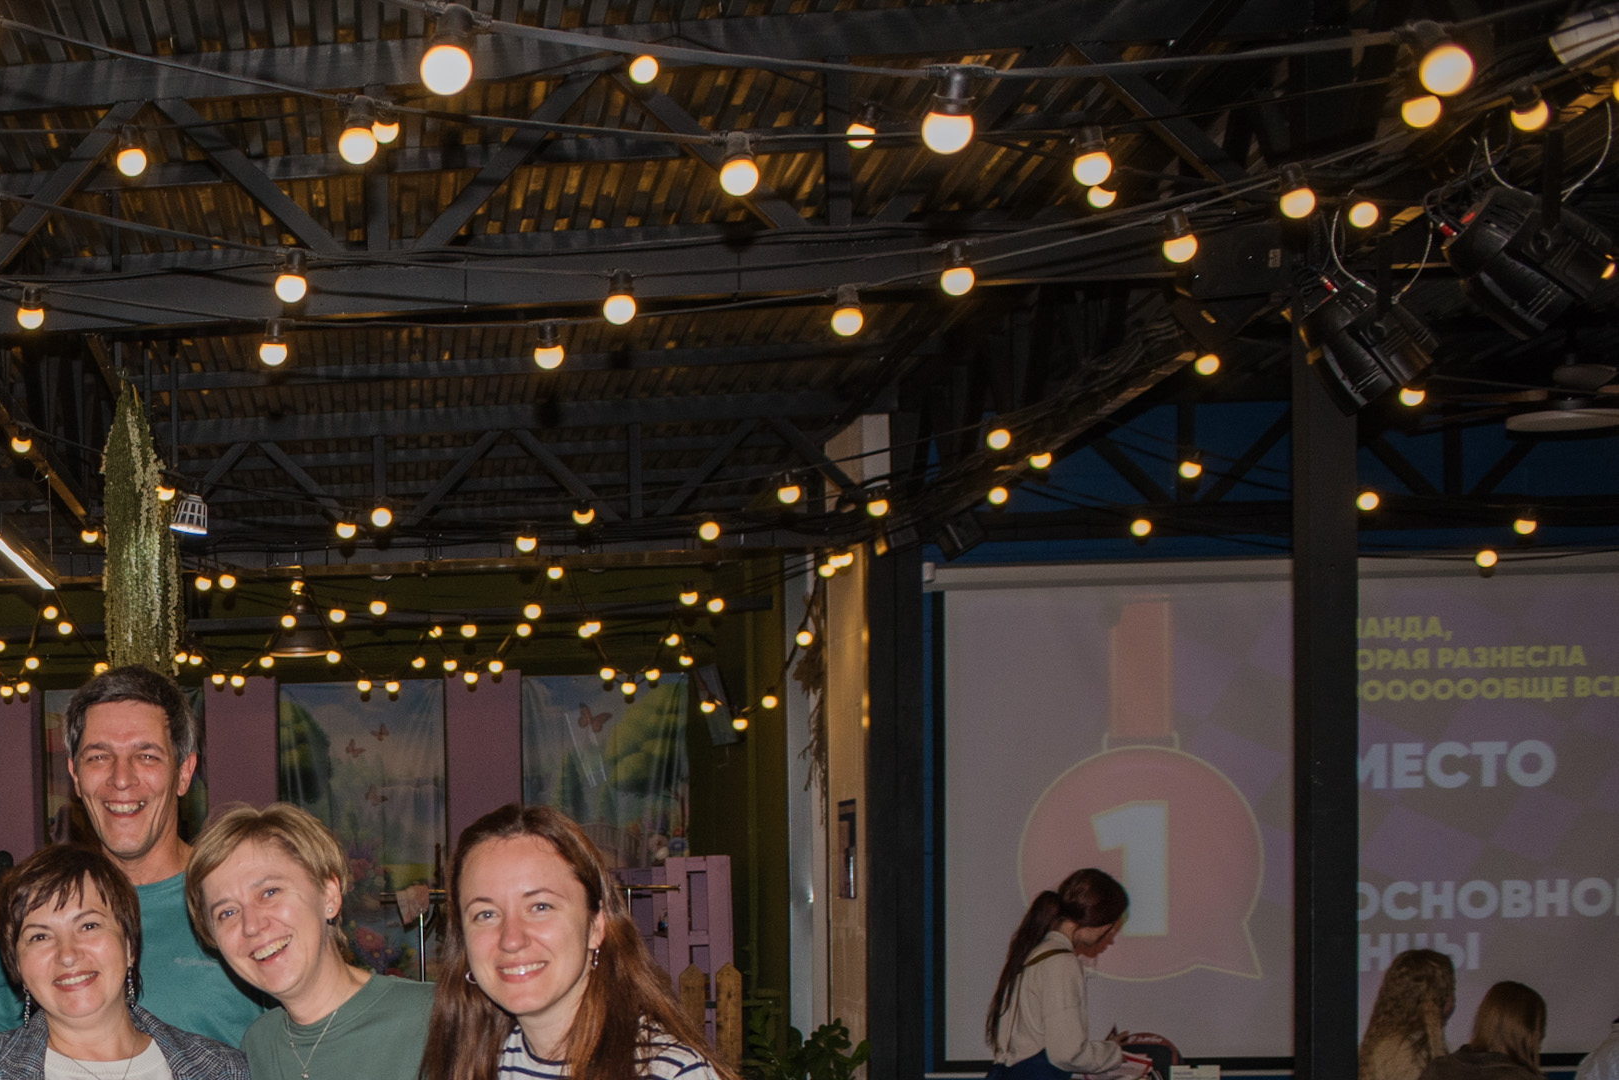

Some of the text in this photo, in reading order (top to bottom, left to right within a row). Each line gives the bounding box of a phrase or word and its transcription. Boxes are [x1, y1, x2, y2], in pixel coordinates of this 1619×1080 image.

[1357, 616, 1453, 641] АНДА,
[1357, 645, 1588, 670] ОРАЯ РАЗНЕСЛА
[1357, 676, 1568, 701] ООООООБЩЕ
[1091, 800, 1169, 937] 1
[1357, 877, 1619, 921] ОСНОВНО
